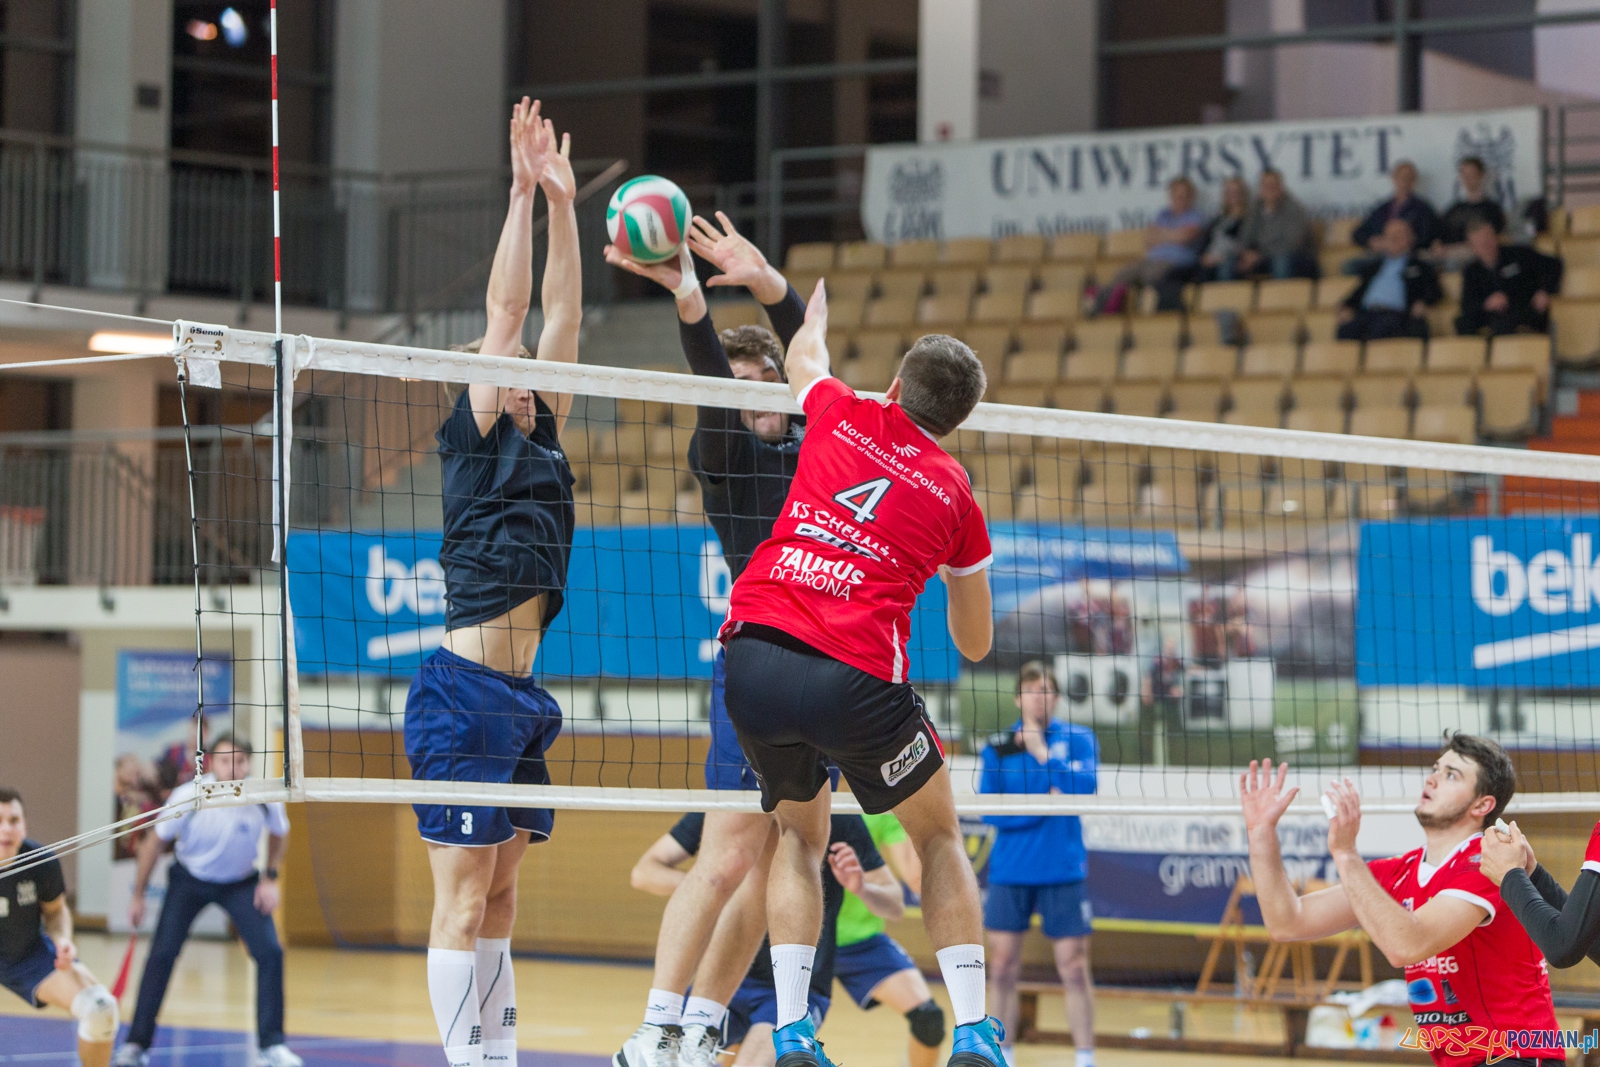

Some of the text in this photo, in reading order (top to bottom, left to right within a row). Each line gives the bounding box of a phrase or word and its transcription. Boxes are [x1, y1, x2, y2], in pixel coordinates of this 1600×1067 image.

[989, 126, 1402, 198] UNIWERSYTET
[196, 327, 224, 337] Senoh
[831, 429, 857, 447] Member
[864, 450, 899, 477] Nordzucker
[899, 474, 919, 489] Group
[837, 419, 951, 506] Nordzucker Polska
[788, 500, 811, 519] KS
[832, 476, 894, 525] 4
[1471, 533, 1600, 617] bek
[461, 812, 473, 835] 3
